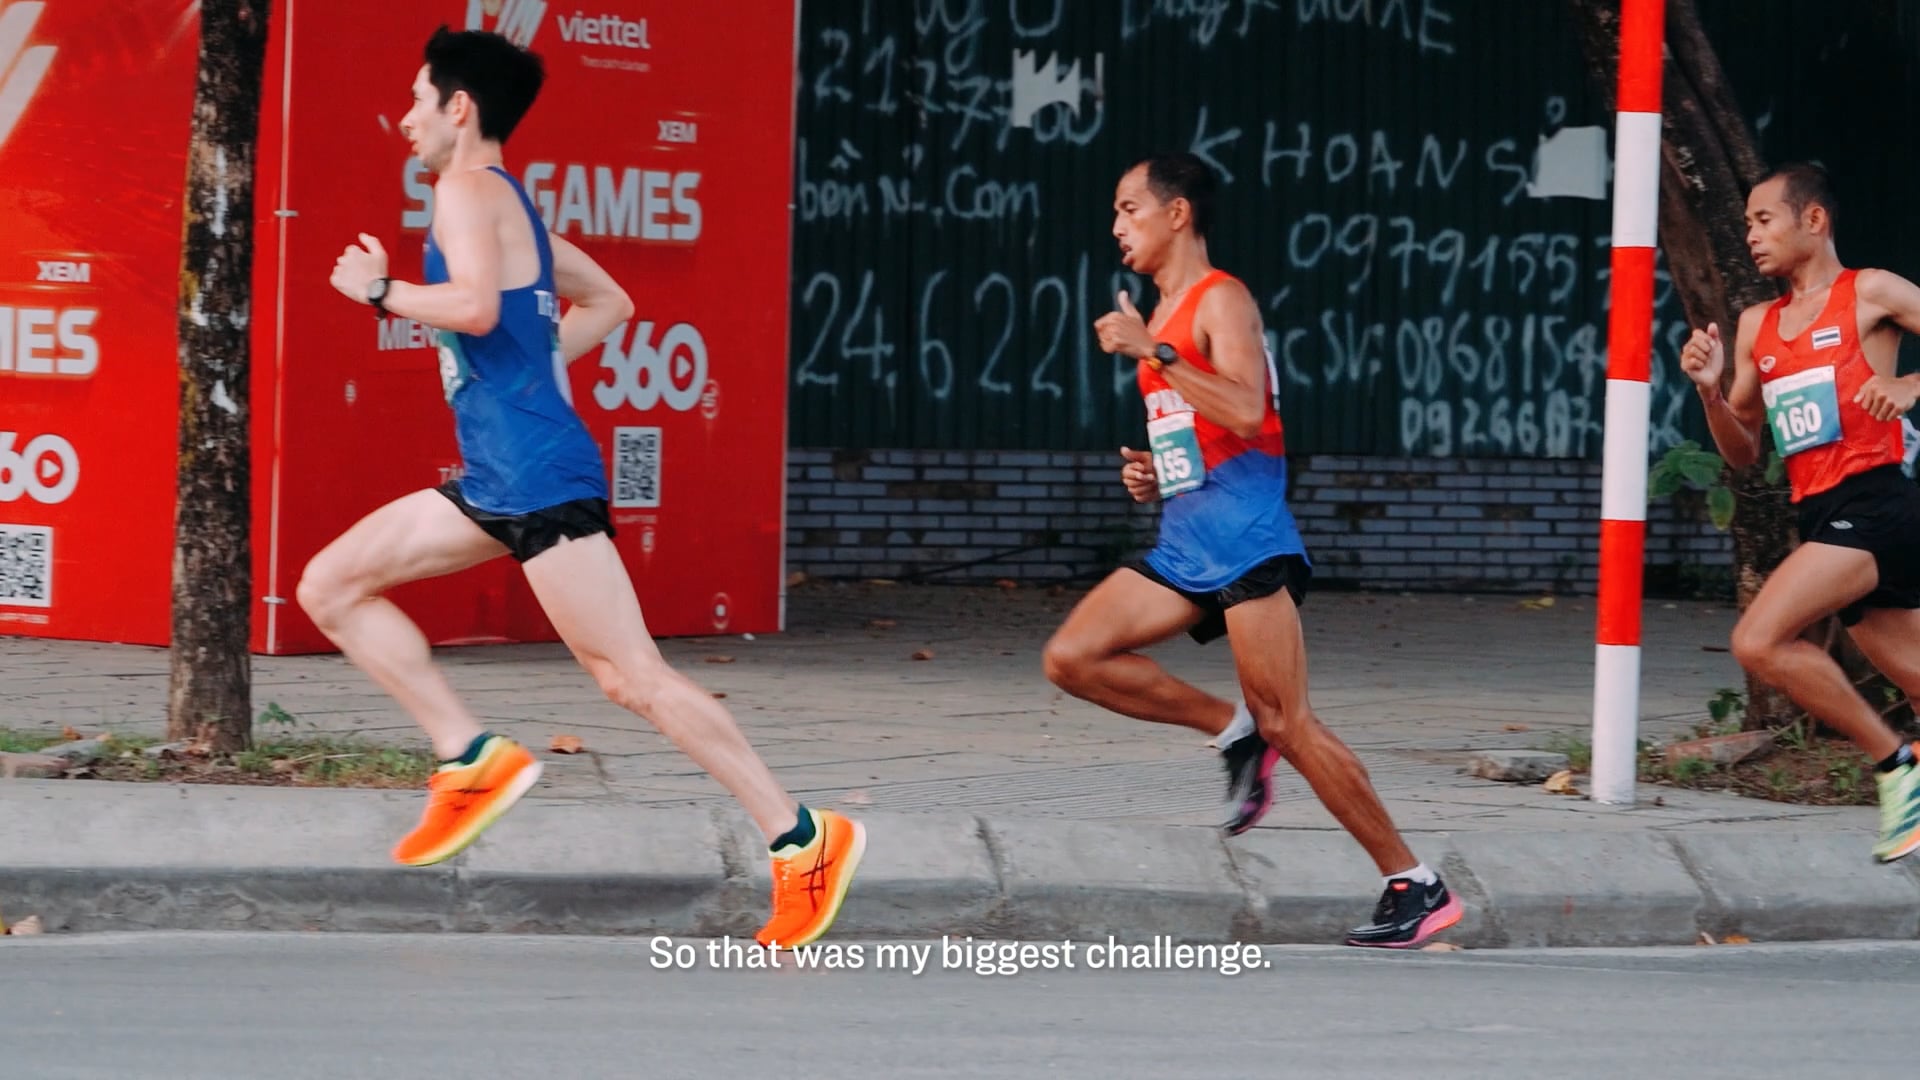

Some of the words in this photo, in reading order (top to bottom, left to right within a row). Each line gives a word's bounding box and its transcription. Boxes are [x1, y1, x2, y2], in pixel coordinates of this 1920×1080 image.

[556, 13, 651, 50] viettel
[657, 119, 697, 144] XEM
[522, 161, 702, 242] GAMES
[36, 260, 91, 283] XEM
[1775, 401, 1822, 441] 160
